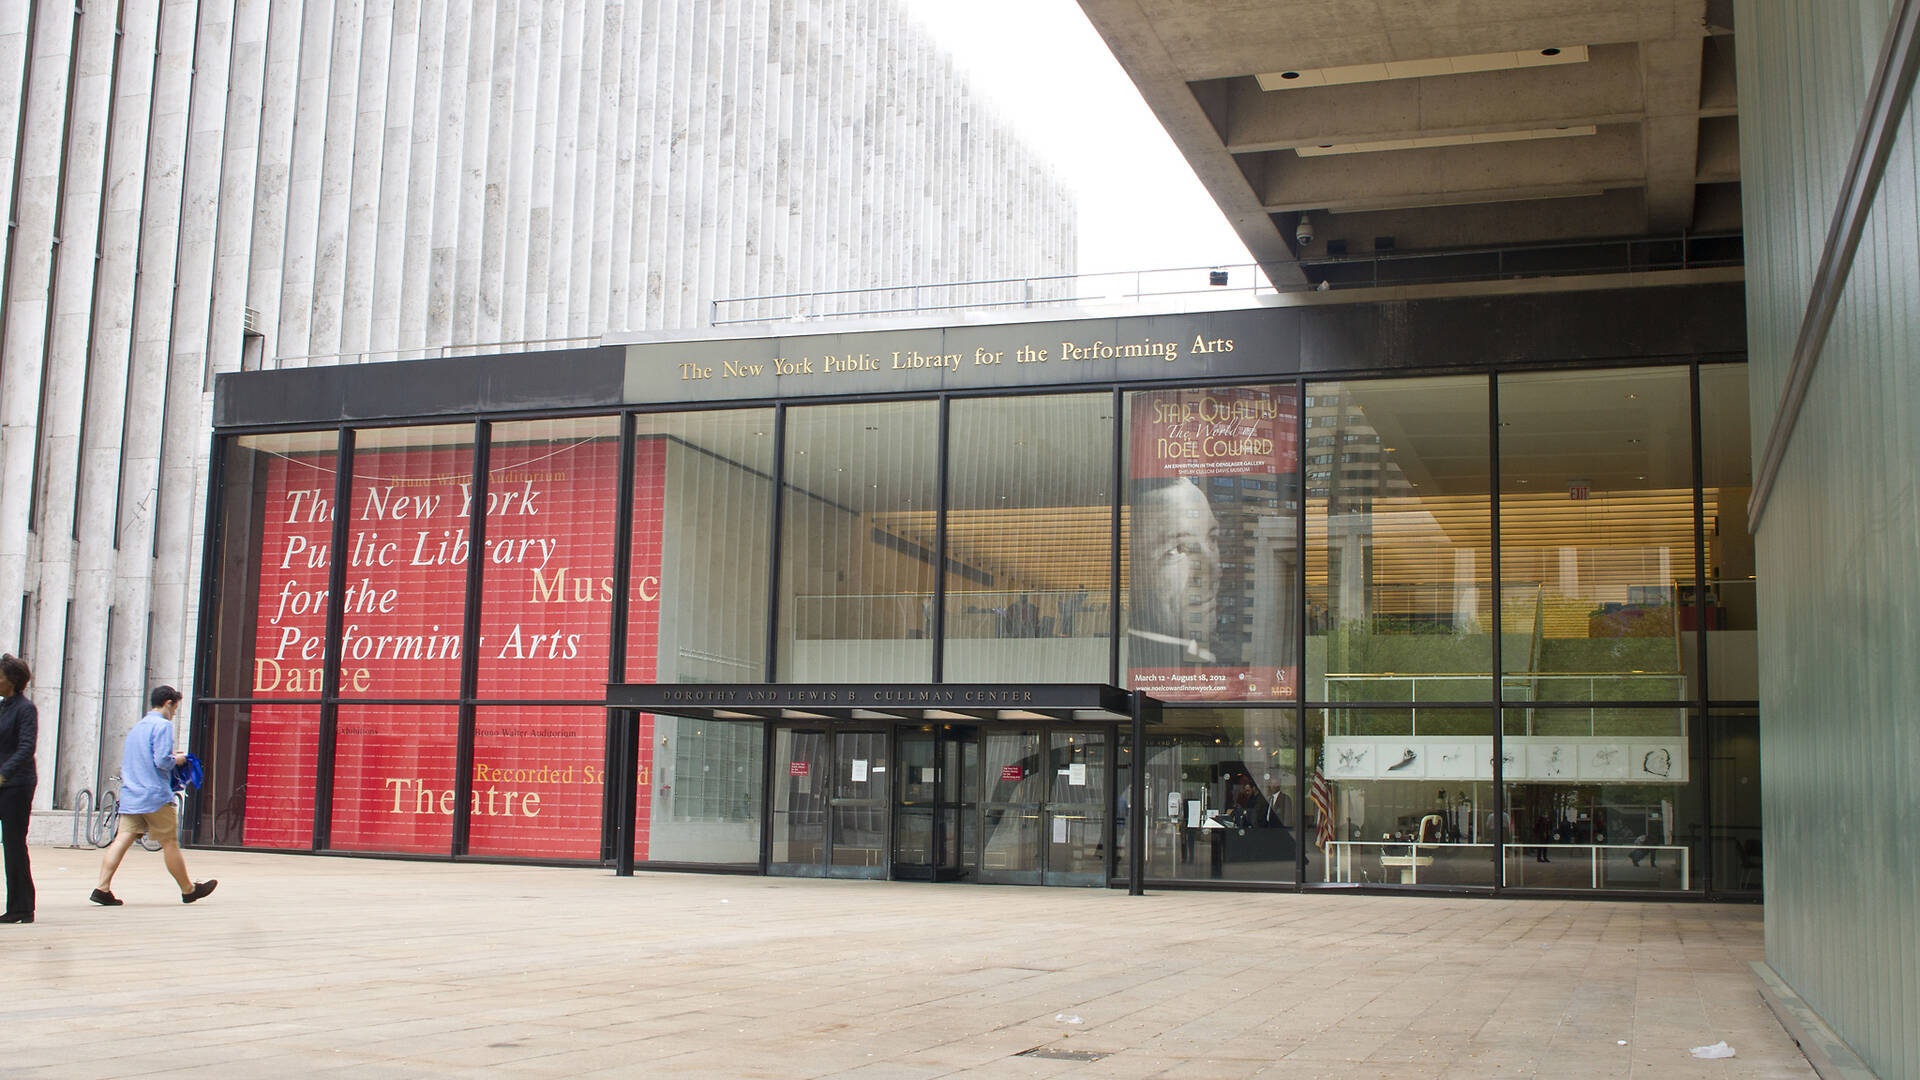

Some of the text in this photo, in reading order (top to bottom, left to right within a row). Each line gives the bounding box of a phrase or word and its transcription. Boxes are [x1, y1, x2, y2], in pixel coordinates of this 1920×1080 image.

[679, 333, 1234, 380] The New York Public Library for the Performing Arts
[1153, 397, 1278, 425] STAR QUALITY
[1167, 423, 1191, 438] The
[1203, 436, 1273, 457] COWARD
[391, 475, 431, 488] Bruno
[437, 473, 473, 486] Walte
[285, 489, 336, 523] Th
[361, 486, 440, 520] New
[1570, 488, 1589, 500] EXIT
[280, 532, 397, 569] Pulic
[529, 568, 658, 603] Musc
[270, 578, 397, 624] for the
[274, 624, 581, 662] Peformin Arts
[1171, 674, 1196, 682] August
[1198, 674, 1208, 682] 18,
[664, 691, 736, 700] DOROTHY
[747, 691, 777, 700] AND
[788, 691, 837, 700] LEWIS
[873, 691, 953, 700] CULLMAN
[965, 691, 1031, 700] CENTER
[502, 729, 527, 737] Walter
[531, 729, 576, 737] Auditorium
[476, 763, 649, 785] Recorded Sod
[385, 778, 541, 817] Theatre
